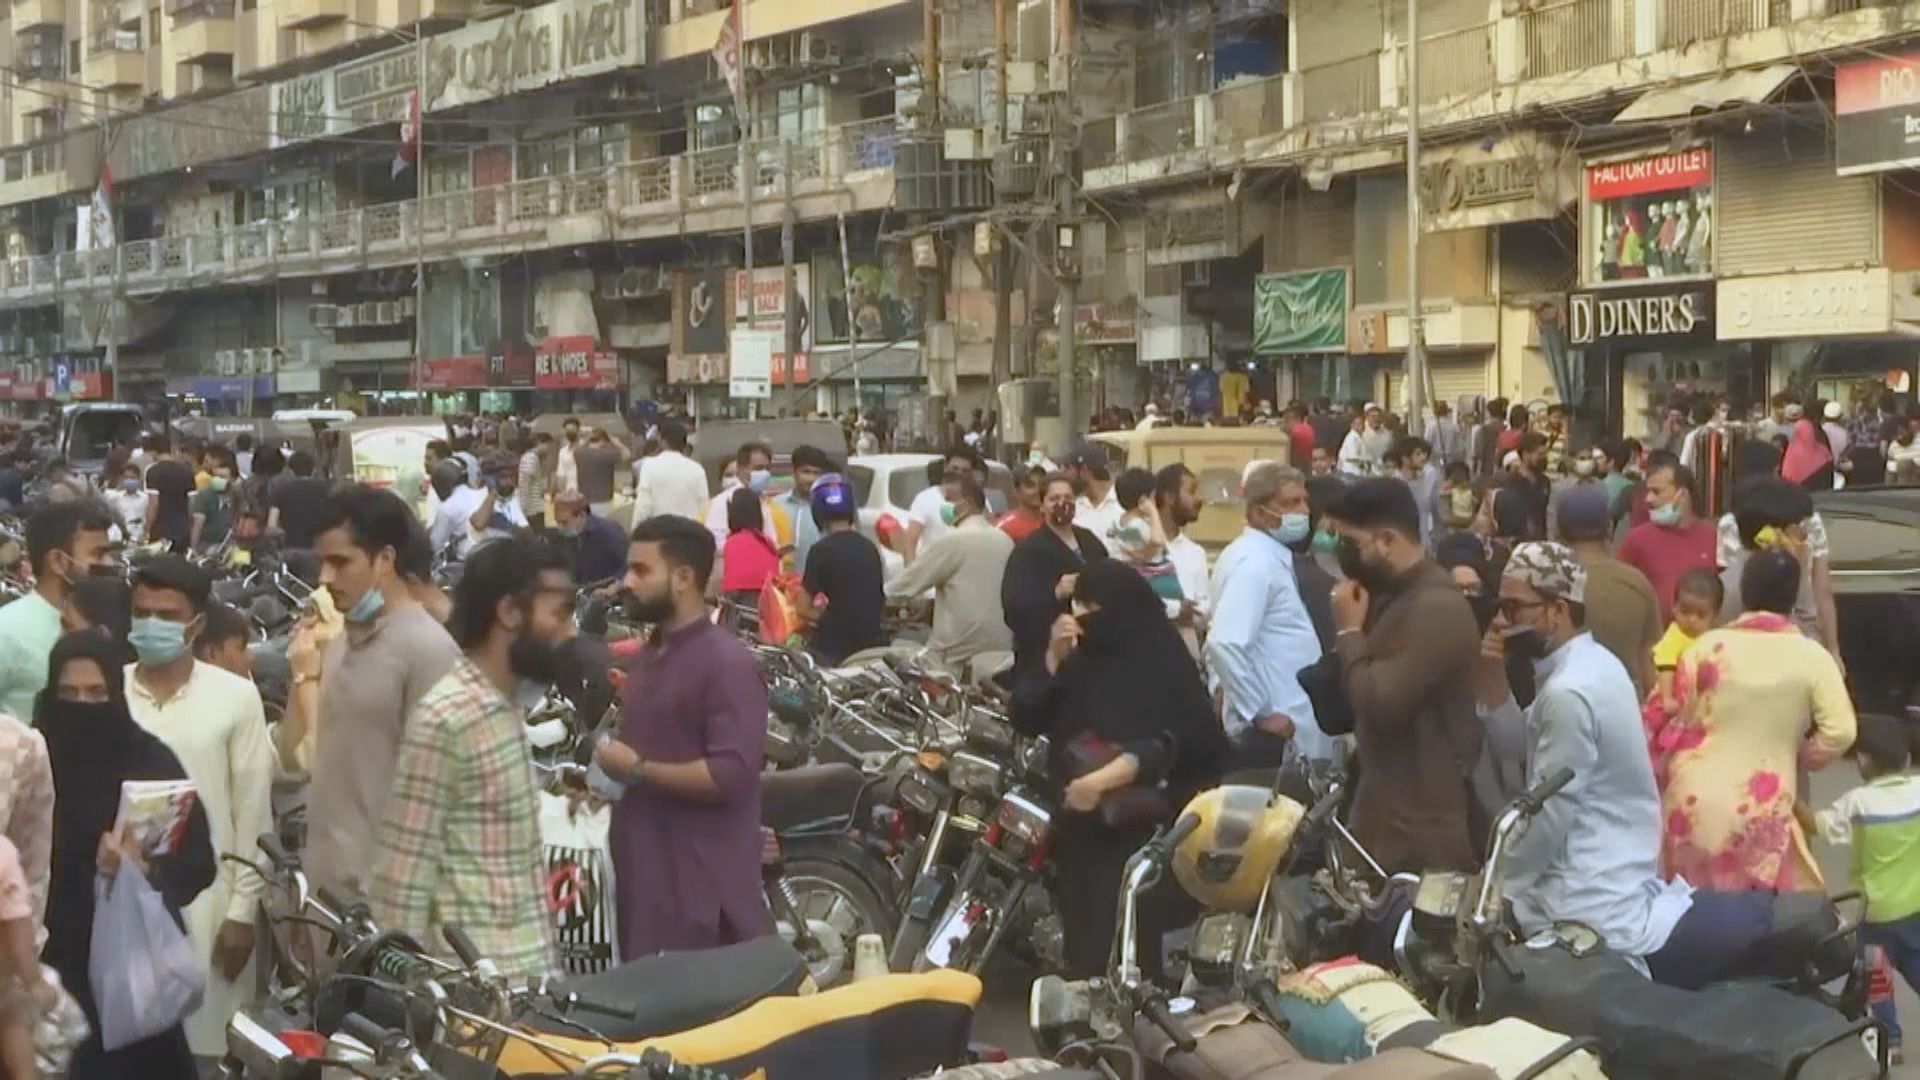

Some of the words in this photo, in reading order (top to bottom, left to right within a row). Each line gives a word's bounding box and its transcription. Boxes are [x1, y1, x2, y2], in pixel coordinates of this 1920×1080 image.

[1593, 159, 1651, 185] FACTORY
[1654, 149, 1707, 175] OUTLET
[1572, 298, 1592, 342] D
[1598, 293, 1696, 337] DINERS
[56, 364, 67, 386] P
